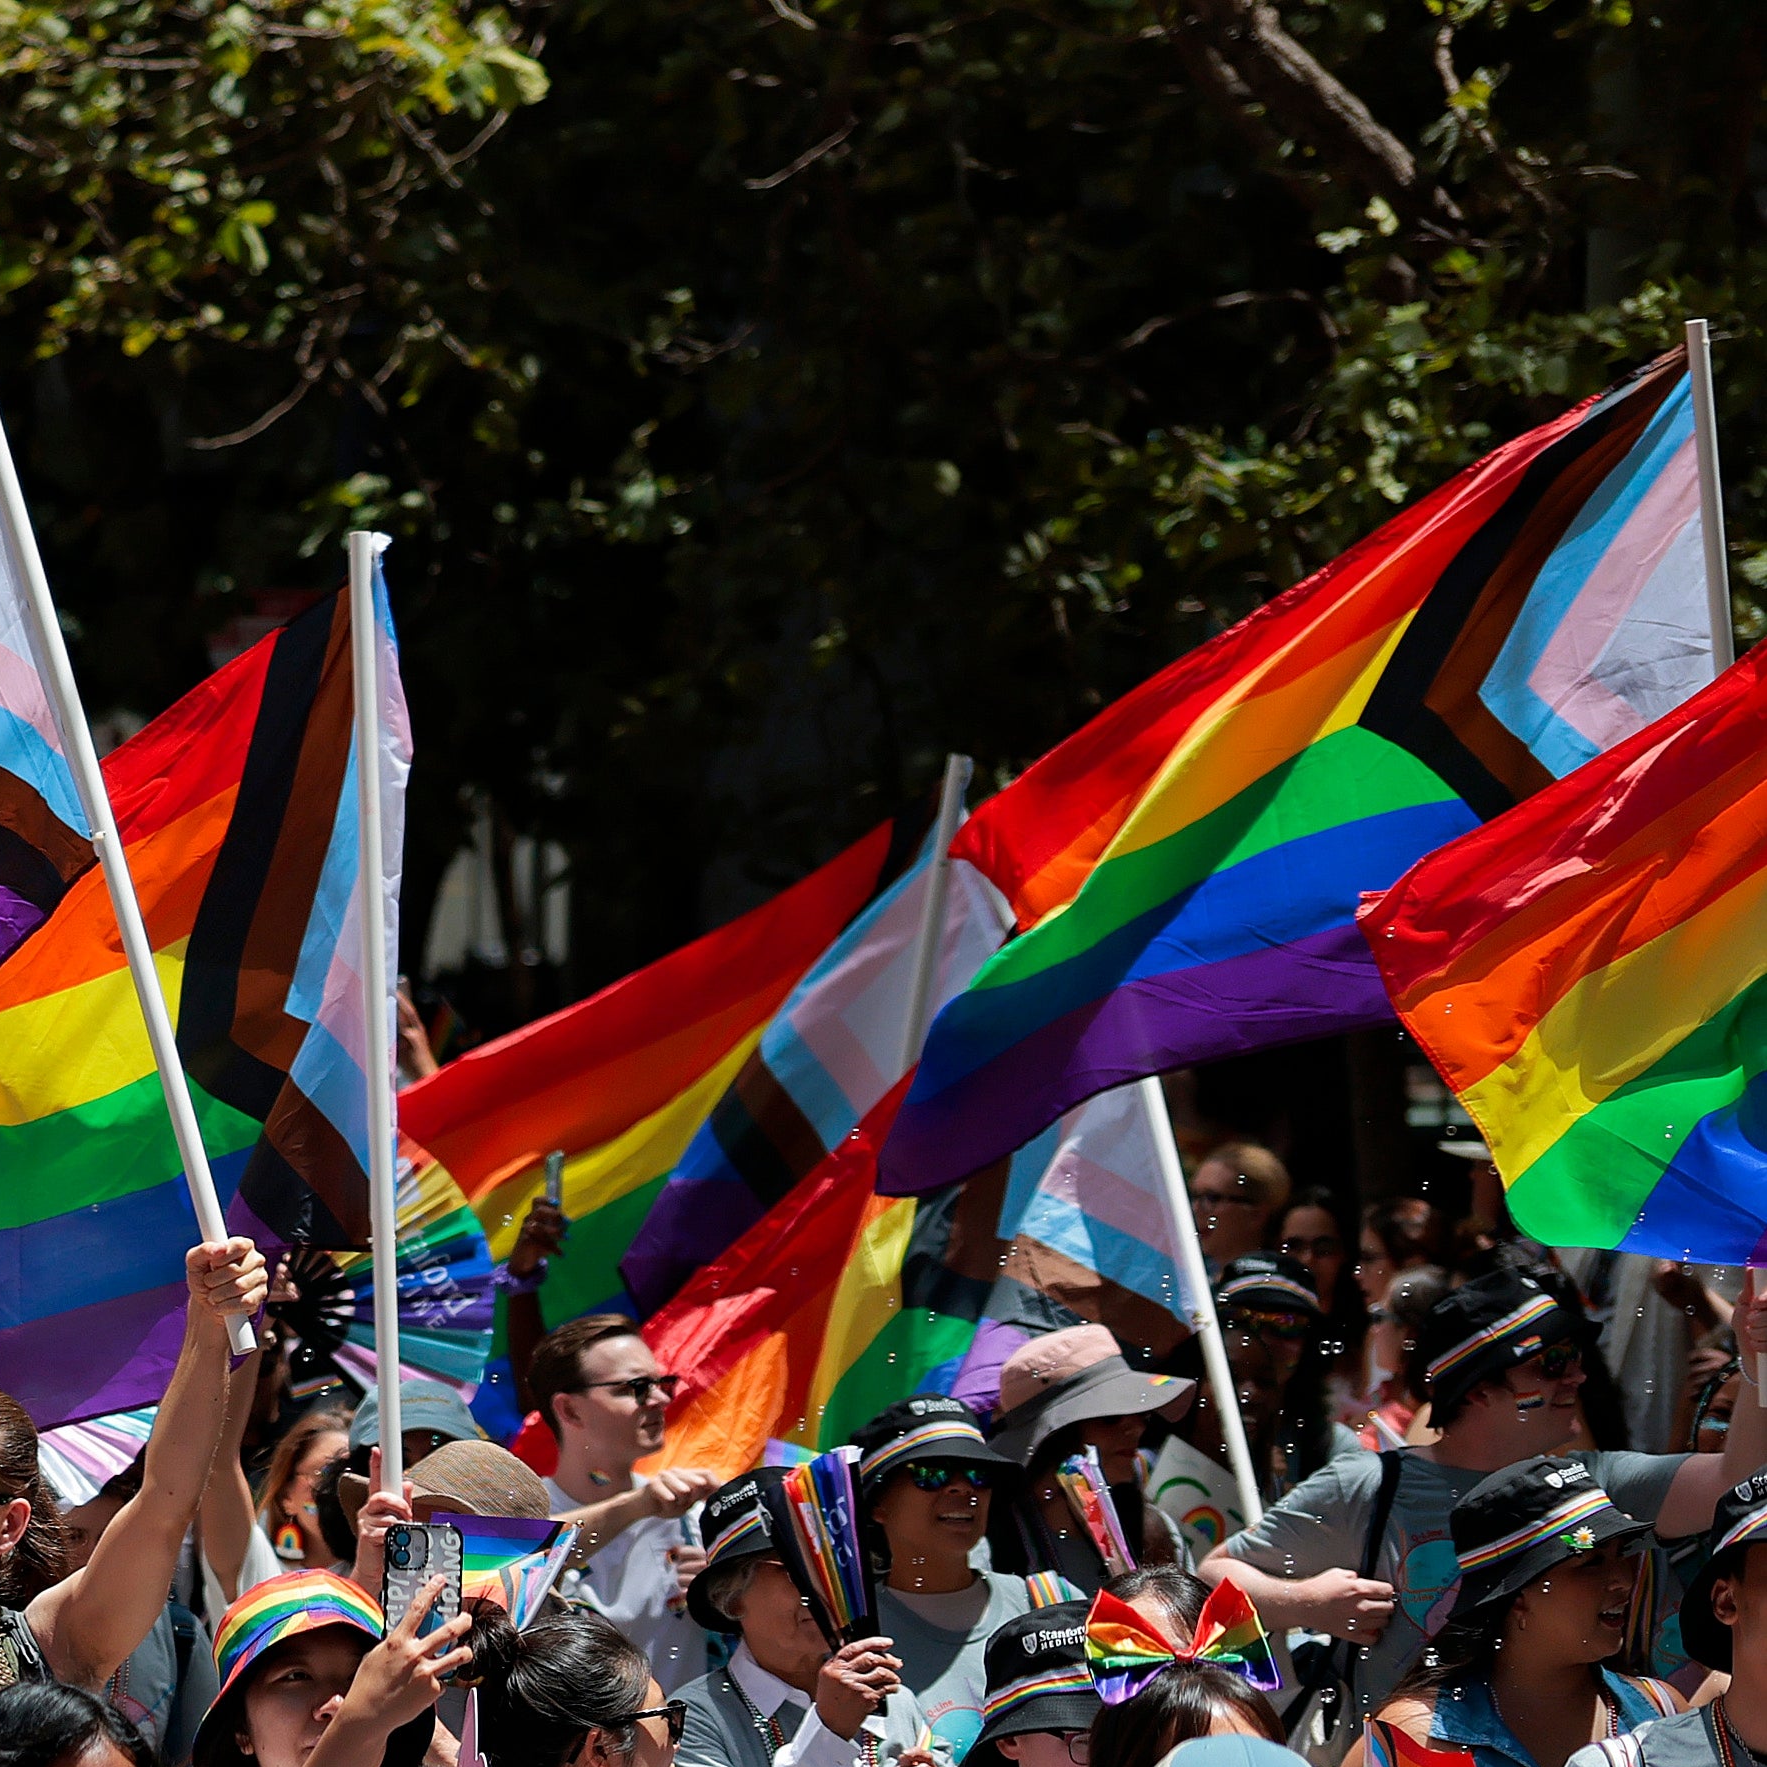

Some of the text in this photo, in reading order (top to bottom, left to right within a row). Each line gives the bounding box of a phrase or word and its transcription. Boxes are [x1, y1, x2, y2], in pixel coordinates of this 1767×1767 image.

[1038, 1625, 1086, 1641] Stanfor
[1040, 1635, 1085, 1651] MEDICIN
[926, 1700, 953, 1717] Q-Line
